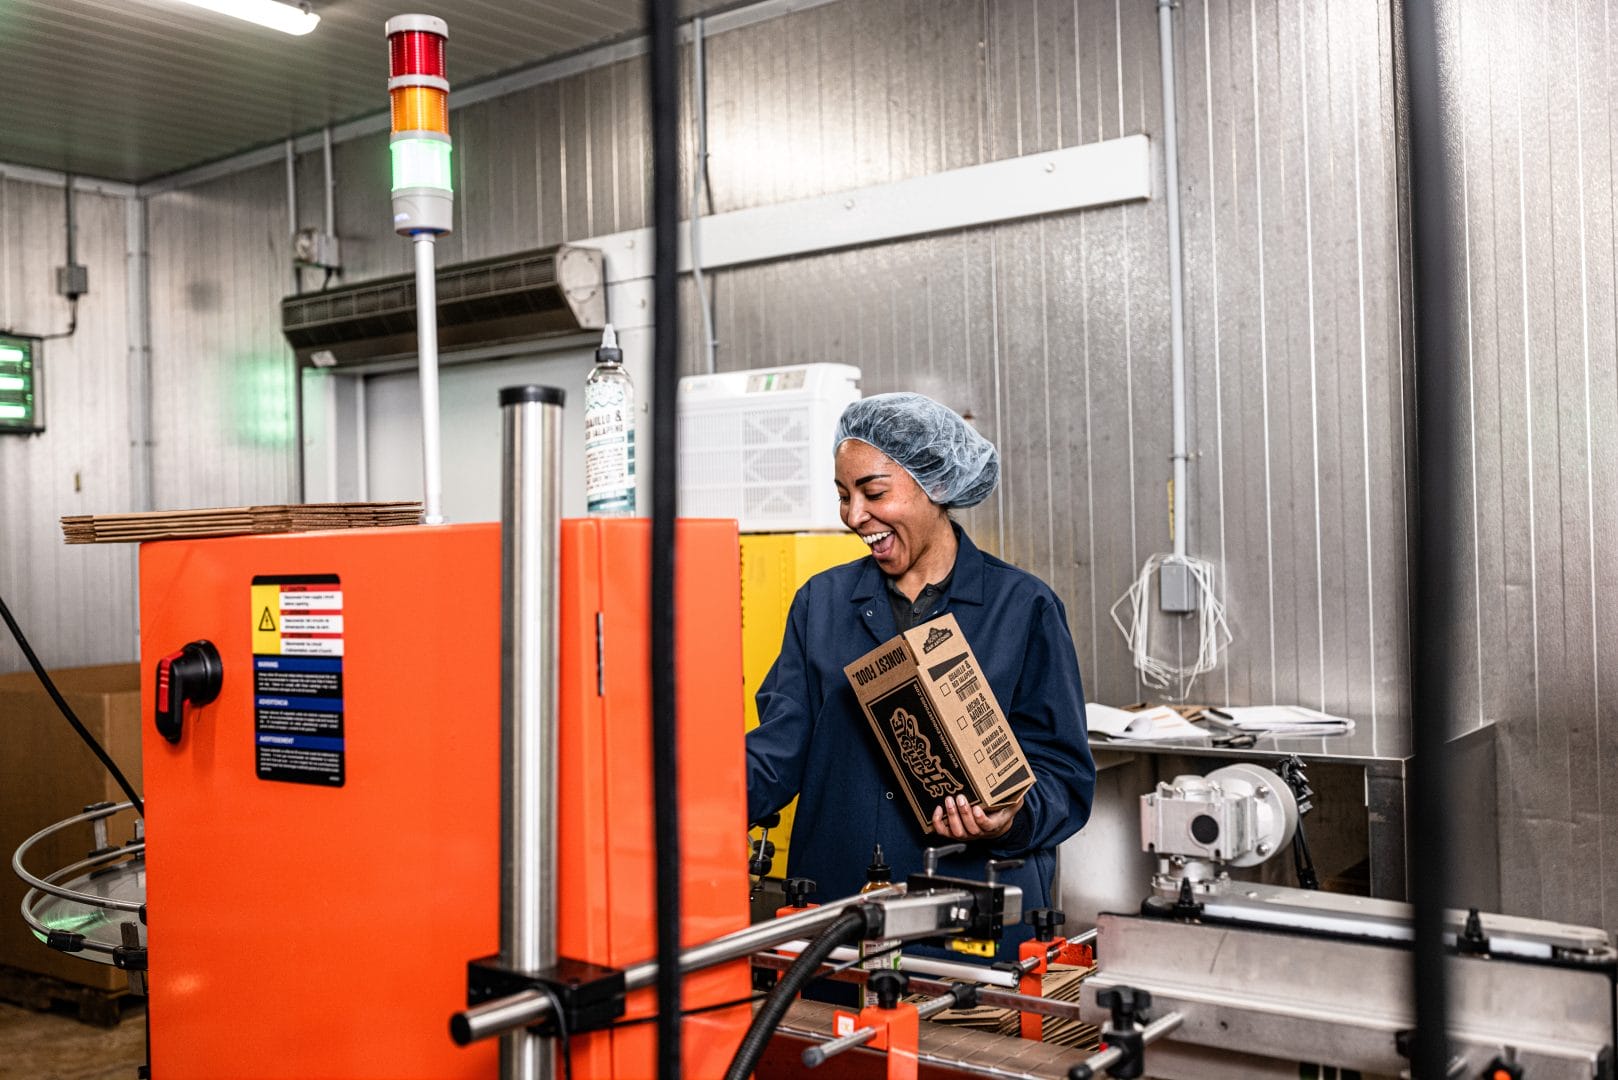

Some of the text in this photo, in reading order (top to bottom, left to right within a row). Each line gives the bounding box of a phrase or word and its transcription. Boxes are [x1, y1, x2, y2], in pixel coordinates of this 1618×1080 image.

[615, 409, 622, 422] &
[851, 646, 907, 686] HONEST FOOD.
[963, 659, 972, 670] &
[965, 692, 987, 713] ANCHO &
[969, 701, 991, 722] MORITA
[996, 725, 1005, 734] &
